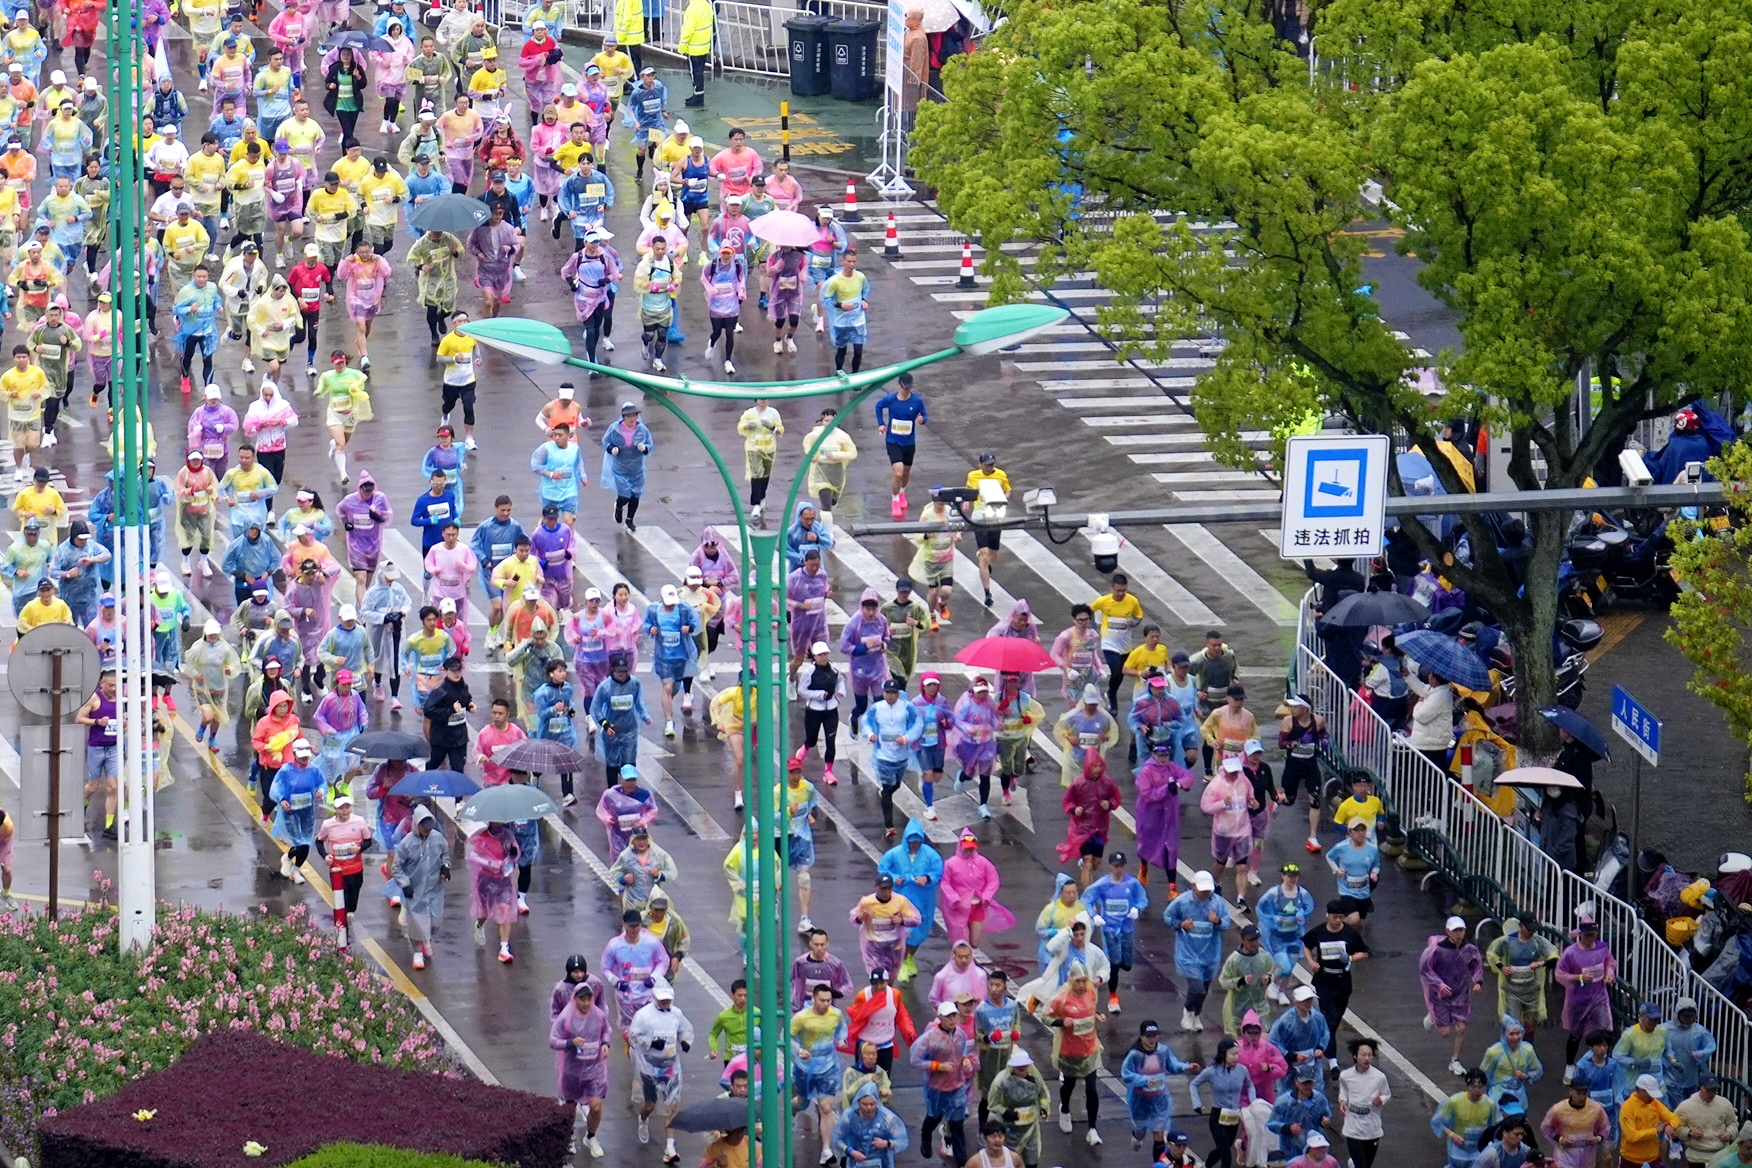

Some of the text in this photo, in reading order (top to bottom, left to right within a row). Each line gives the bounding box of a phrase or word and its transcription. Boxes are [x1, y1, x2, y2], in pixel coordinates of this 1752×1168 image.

[1294, 528, 1370, 546] 违法抓拍
[1620, 699, 1651, 741] 人民街
